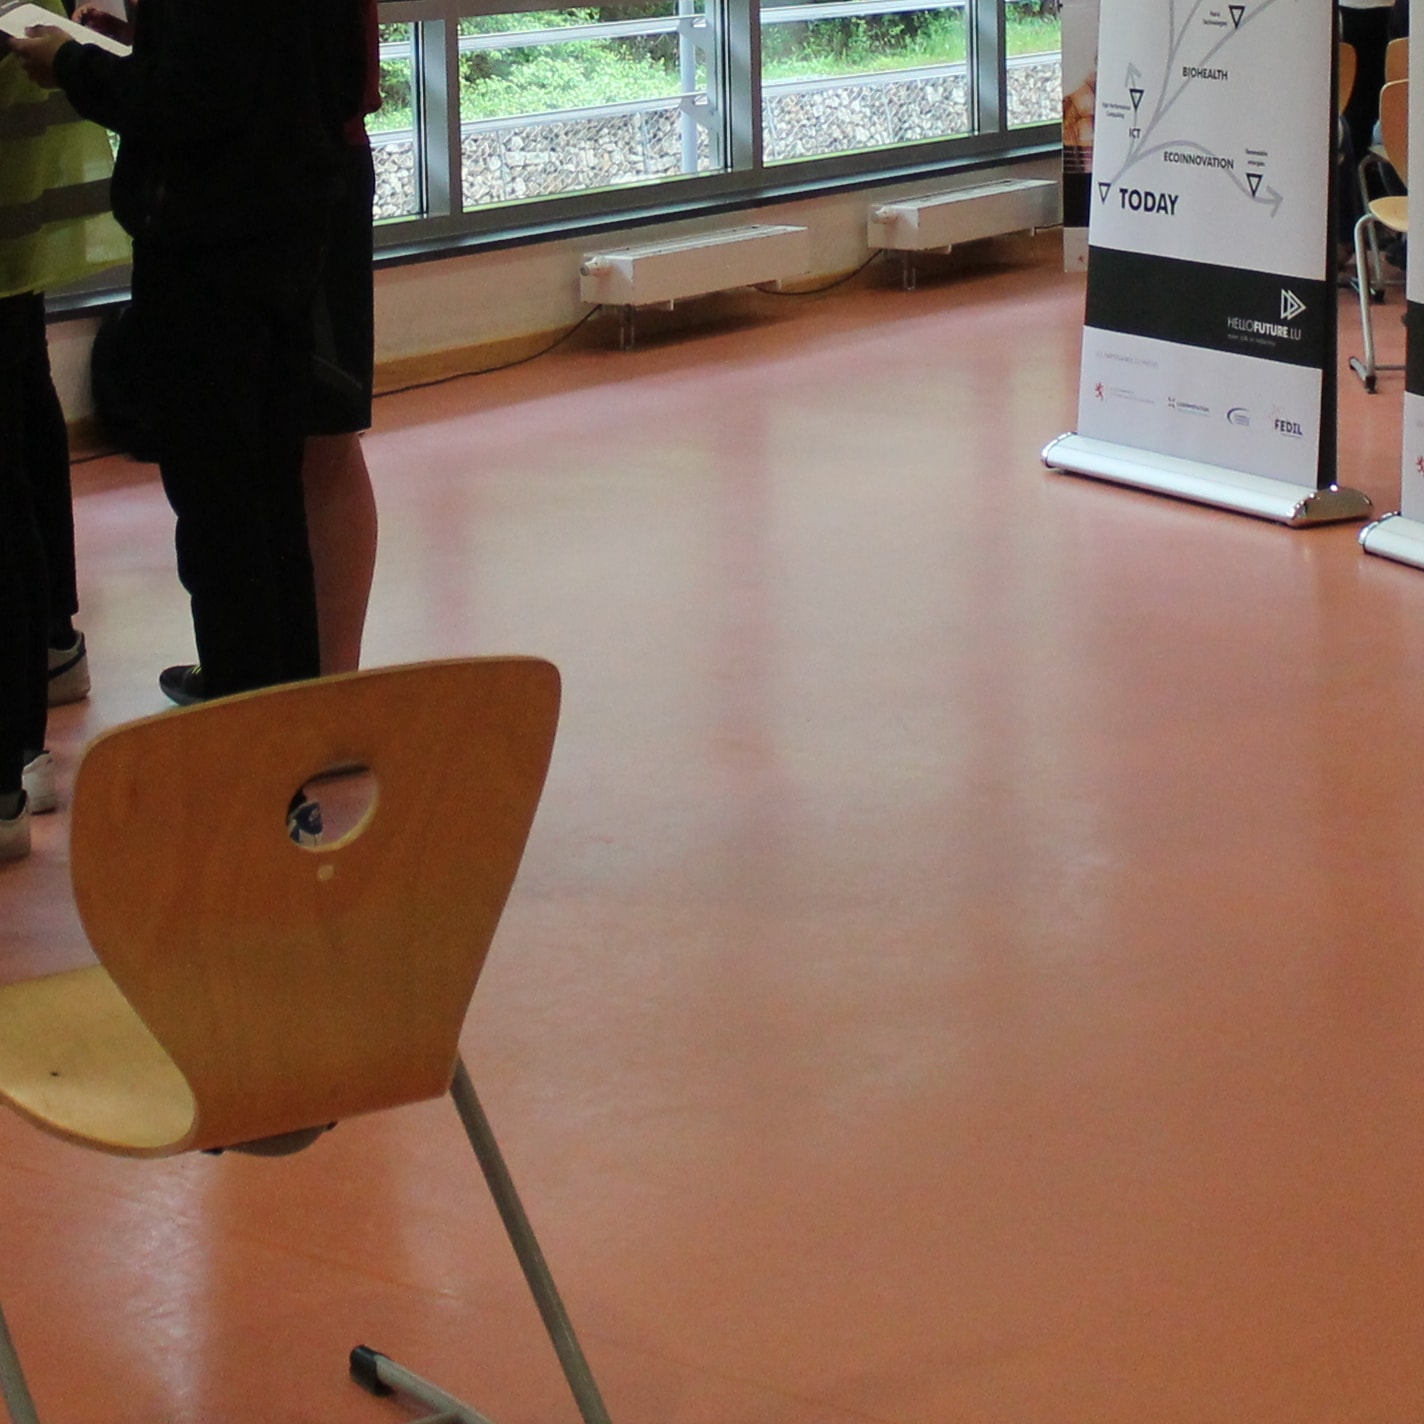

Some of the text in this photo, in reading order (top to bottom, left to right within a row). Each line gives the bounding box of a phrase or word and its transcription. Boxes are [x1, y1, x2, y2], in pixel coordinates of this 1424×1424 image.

[1182, 66, 1229, 80] BIOHEALTH
[1129, 128, 1142, 139] ICT
[1163, 151, 1234, 169] ECOINNOVATION
[1119, 187, 1179, 216] TODAY
[1274, 418, 1303, 436] FEDIL
